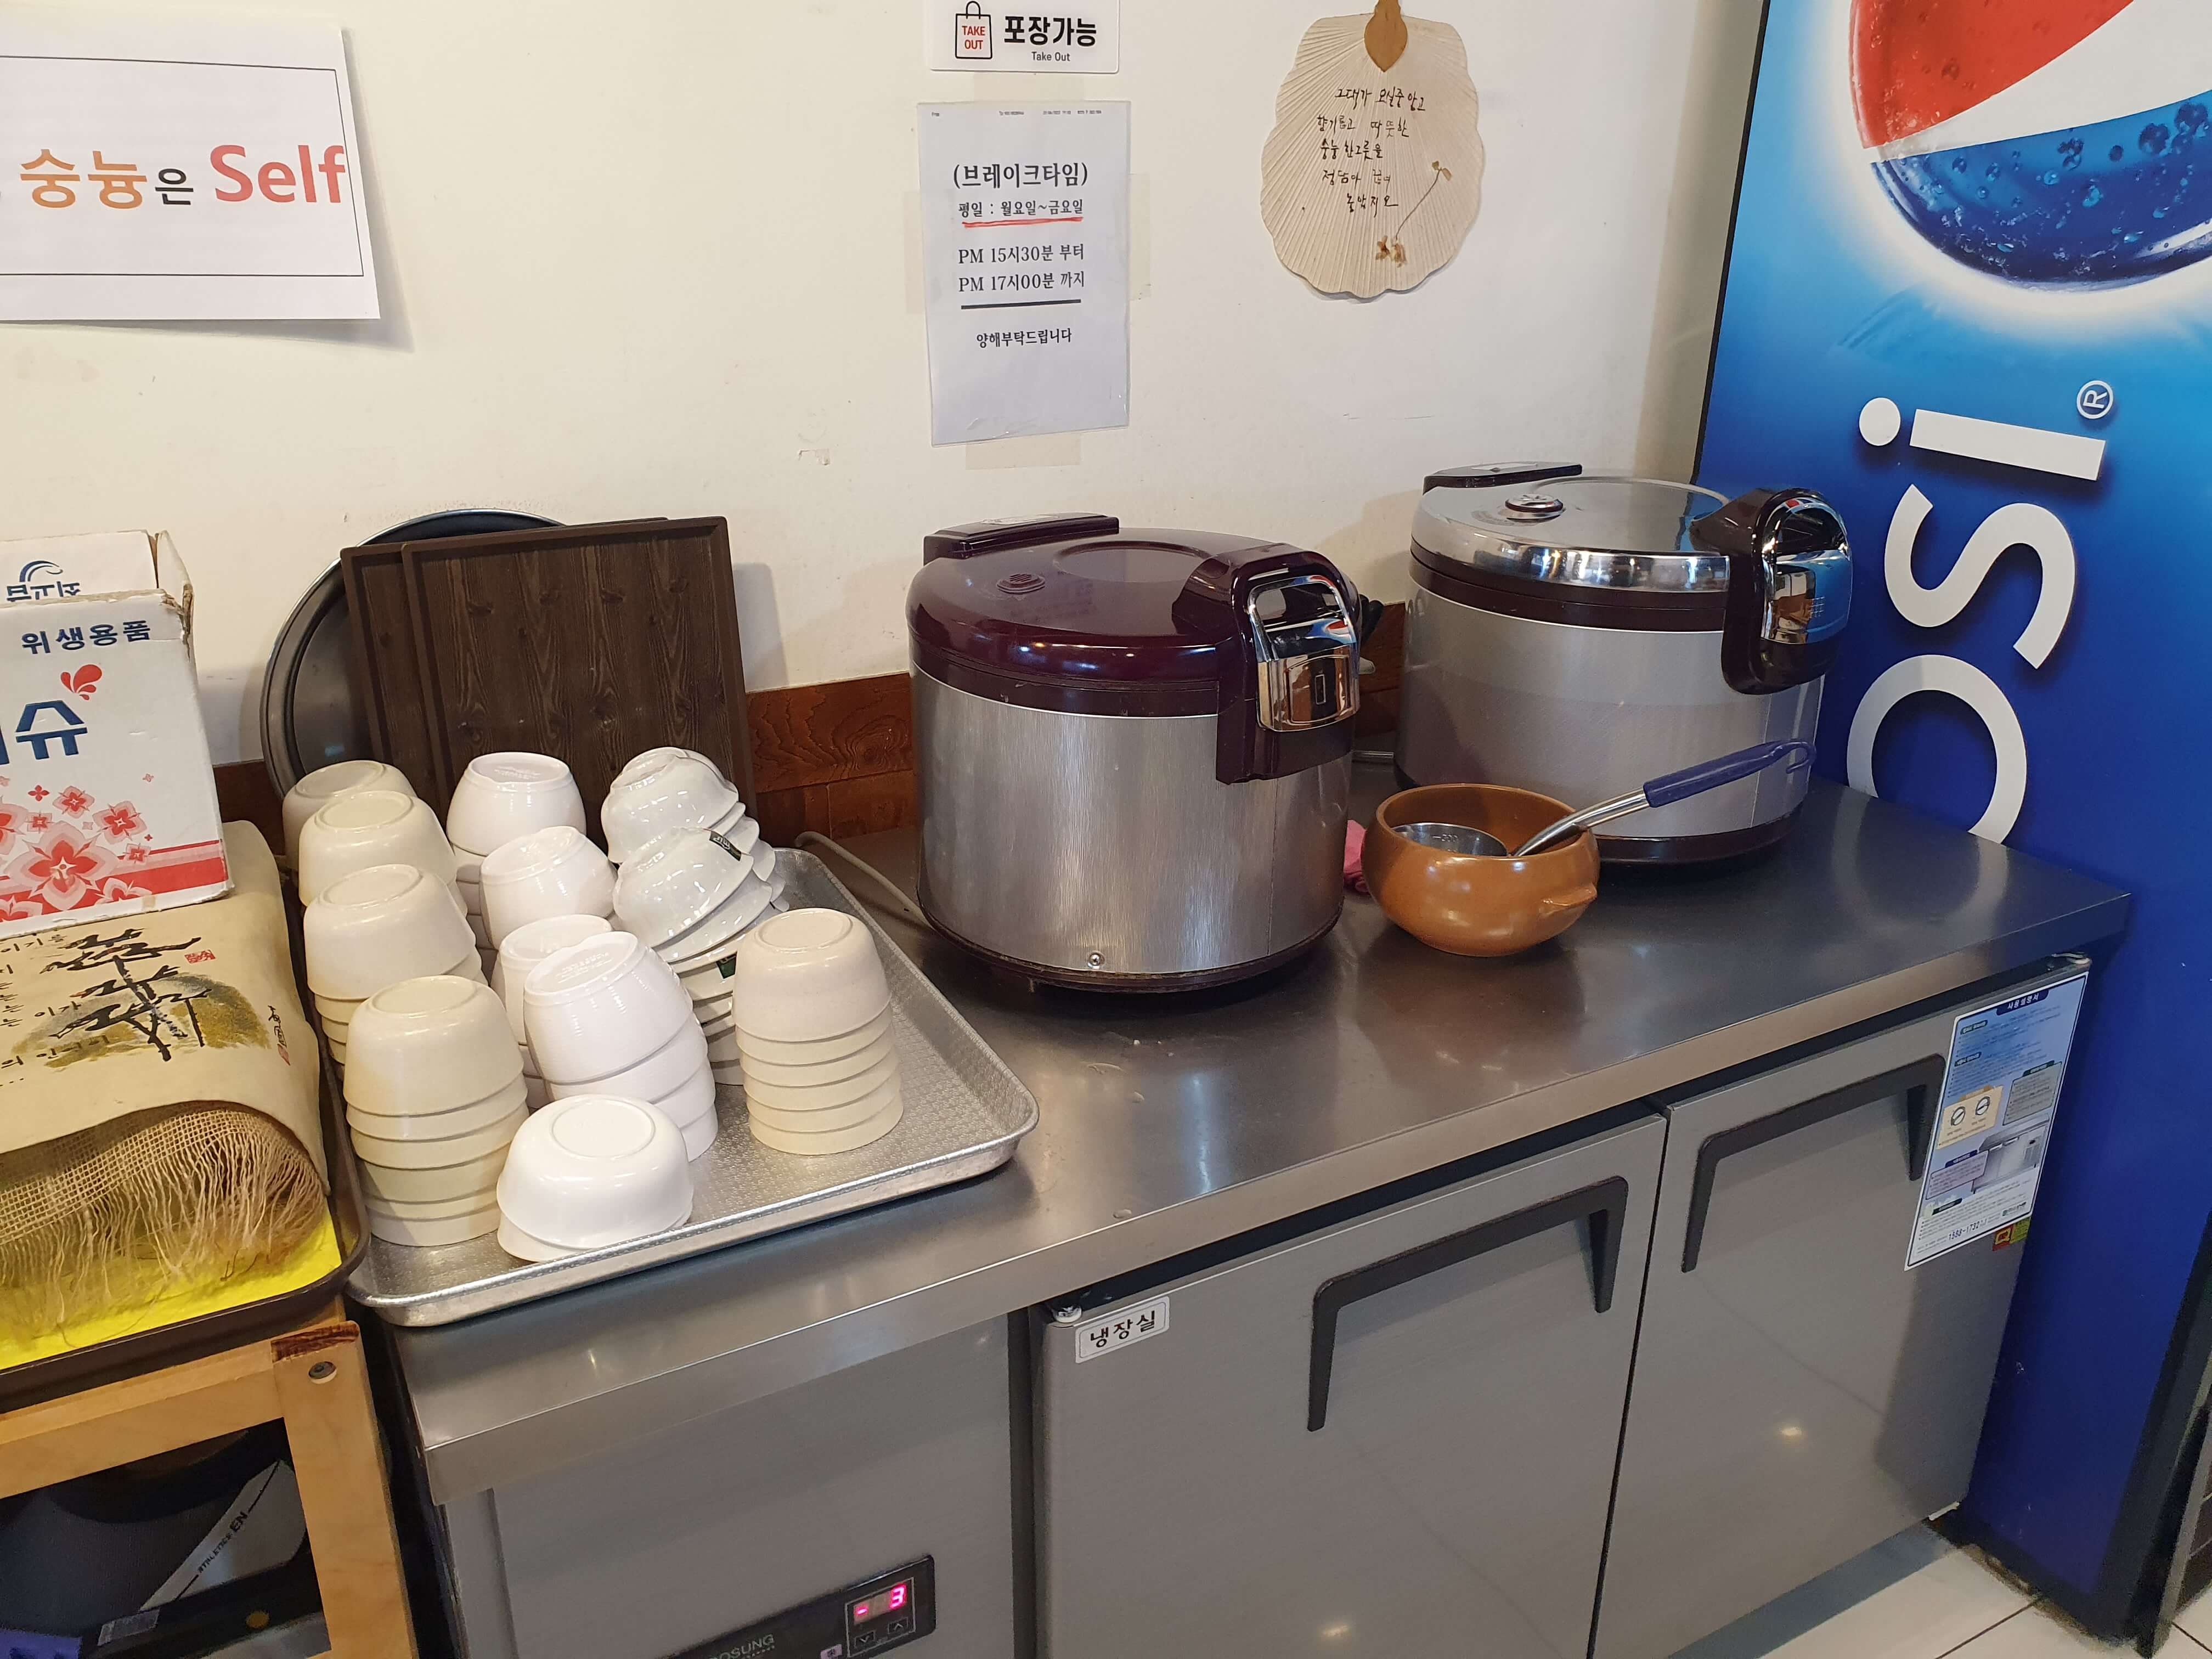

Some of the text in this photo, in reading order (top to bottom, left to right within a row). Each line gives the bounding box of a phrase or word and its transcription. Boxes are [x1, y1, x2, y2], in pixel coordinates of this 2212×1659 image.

[961, 25, 986, 36] TAKE
[1004, 15, 1097, 47] 포장가능
[964, 40, 984, 50] OUT
[1031, 51, 1071, 62] Take Out
[1335, 87, 1373, 110] 그대가
[1370, 117, 1409, 138] 따뜻한
[20, 144, 346, 210] 숭늉은 Self
[953, 162, 1088, 189] (브레이크타임)
[958, 201, 983, 218] 평일
[1000, 199, 1084, 217] 월요일~금요일
[958, 244, 1085, 264] PM 15시30분 부터
[958, 270, 1085, 292] PM 17시00분 까지
[976, 328, 1072, 348] 양해부탁드립니다
[21, 619, 151, 654] 위생용품
[0, 699, 88, 765] 슈
[1090, 1310, 1155, 1348] 냉장실
